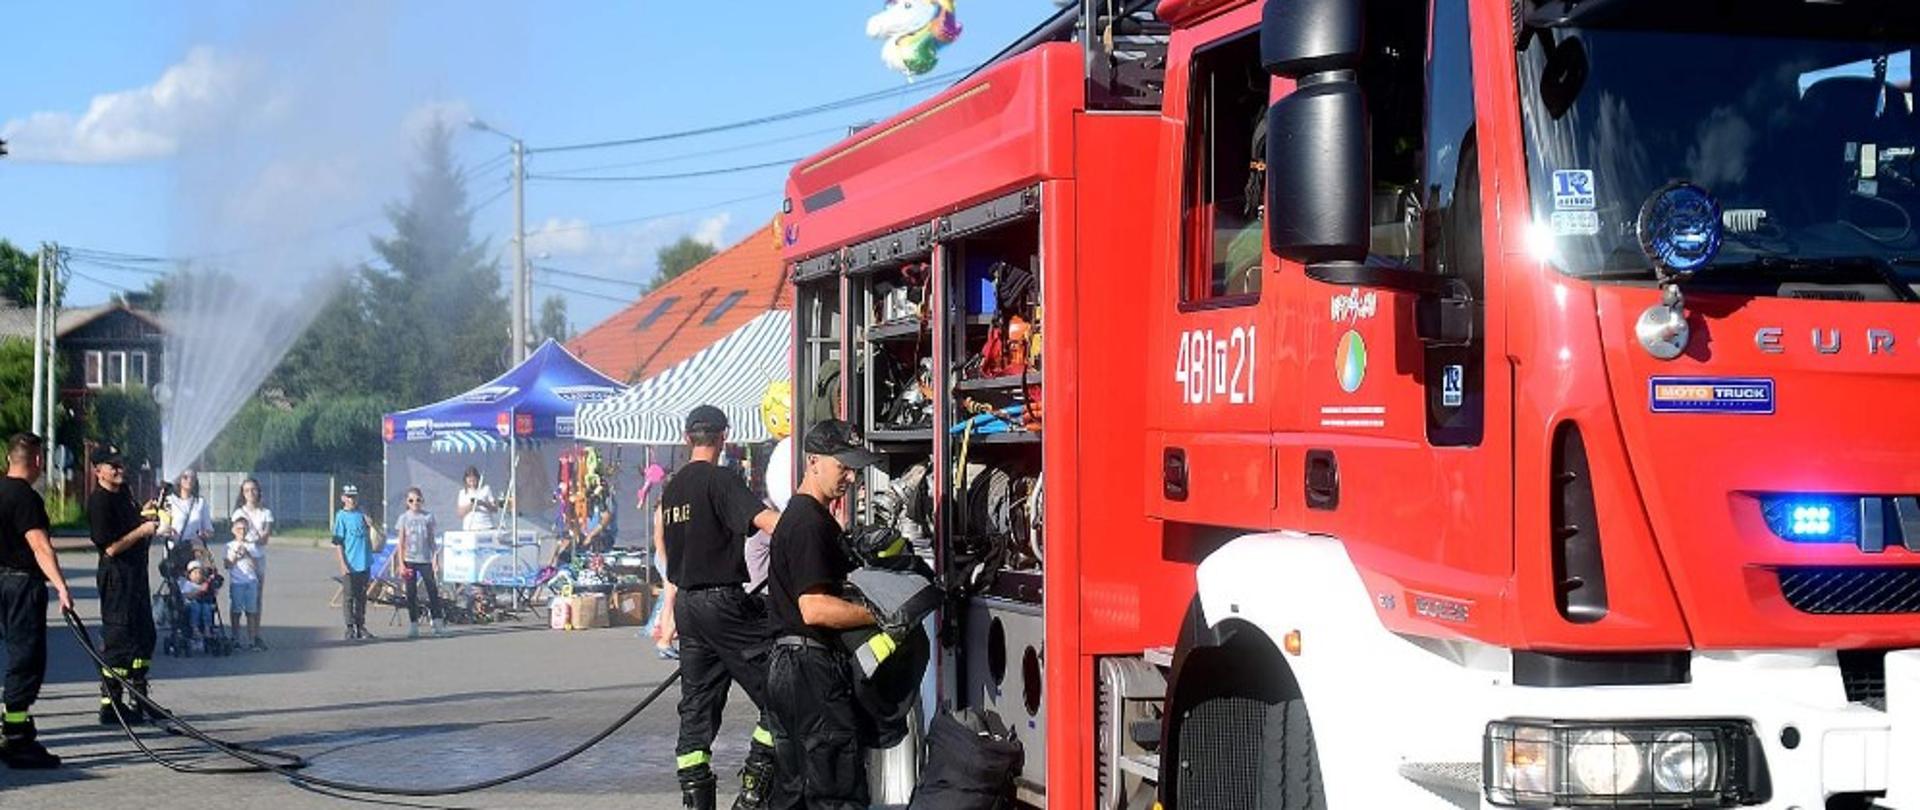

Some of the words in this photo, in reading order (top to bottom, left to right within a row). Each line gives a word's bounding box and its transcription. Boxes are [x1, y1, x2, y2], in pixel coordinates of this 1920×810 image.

[1755, 328, 1920, 353] EUR
[1663, 388, 1708, 398] MOTO
[1715, 388, 1764, 398] TRUCK
